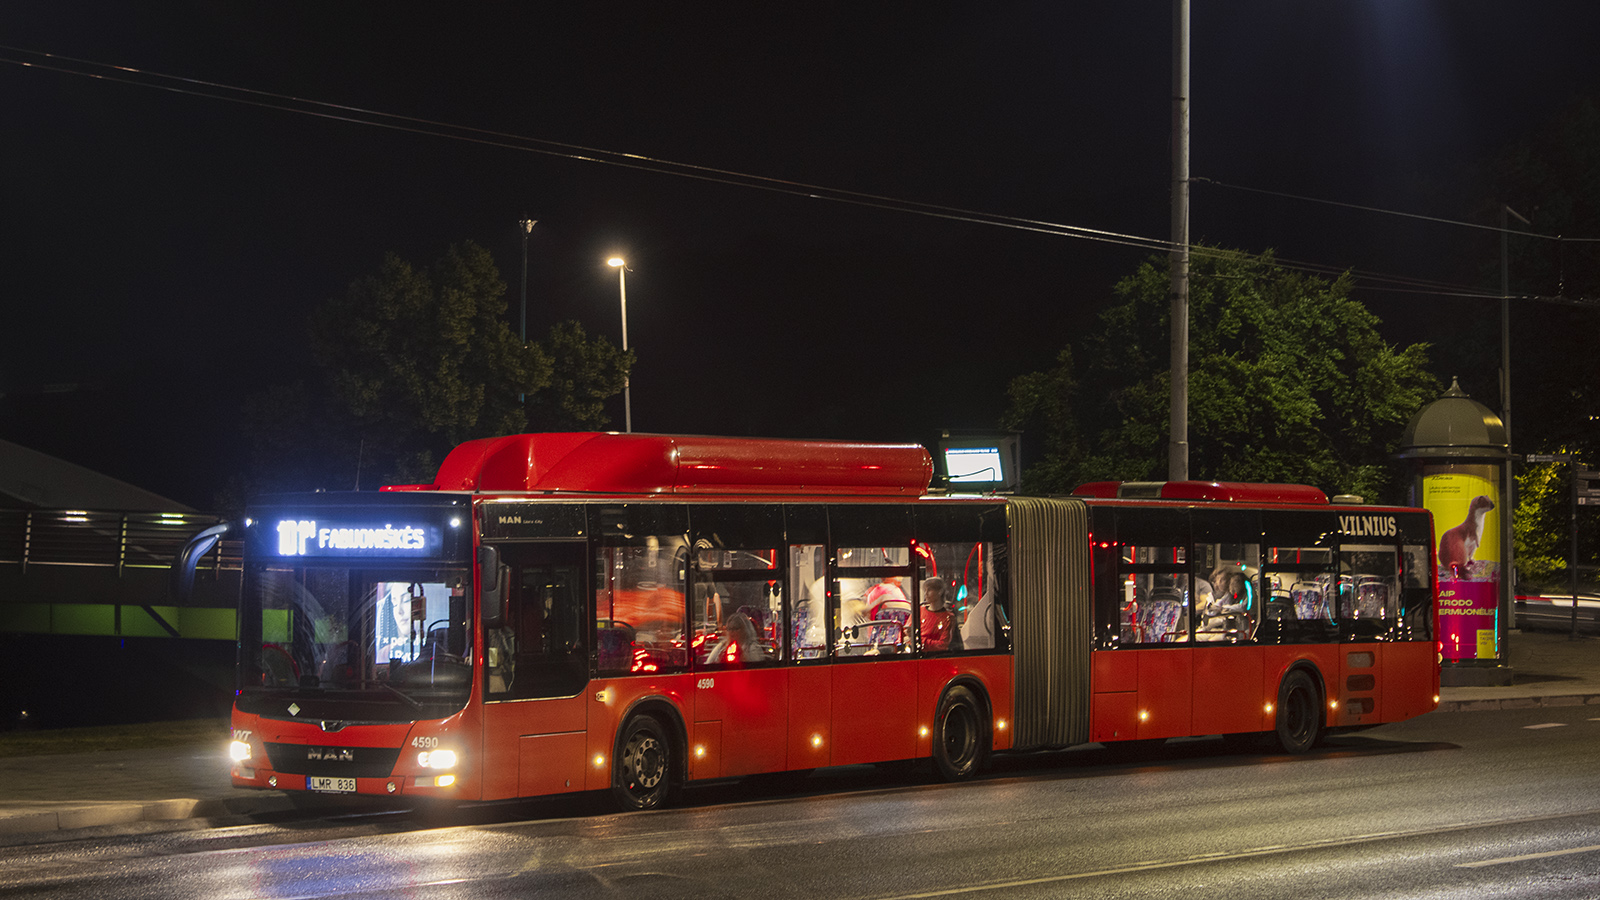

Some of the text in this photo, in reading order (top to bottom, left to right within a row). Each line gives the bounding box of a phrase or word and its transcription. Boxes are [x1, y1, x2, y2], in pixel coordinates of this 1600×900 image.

[498, 516, 522, 524] MAN
[1339, 515, 1397, 537] VILNIUS
[1439, 599, 1473, 607] TRODO
[697, 678, 714, 689] 4590
[411, 736, 439, 748] 4590
[308, 748, 354, 761] MAN
[312, 777, 355, 791] LMR 836
